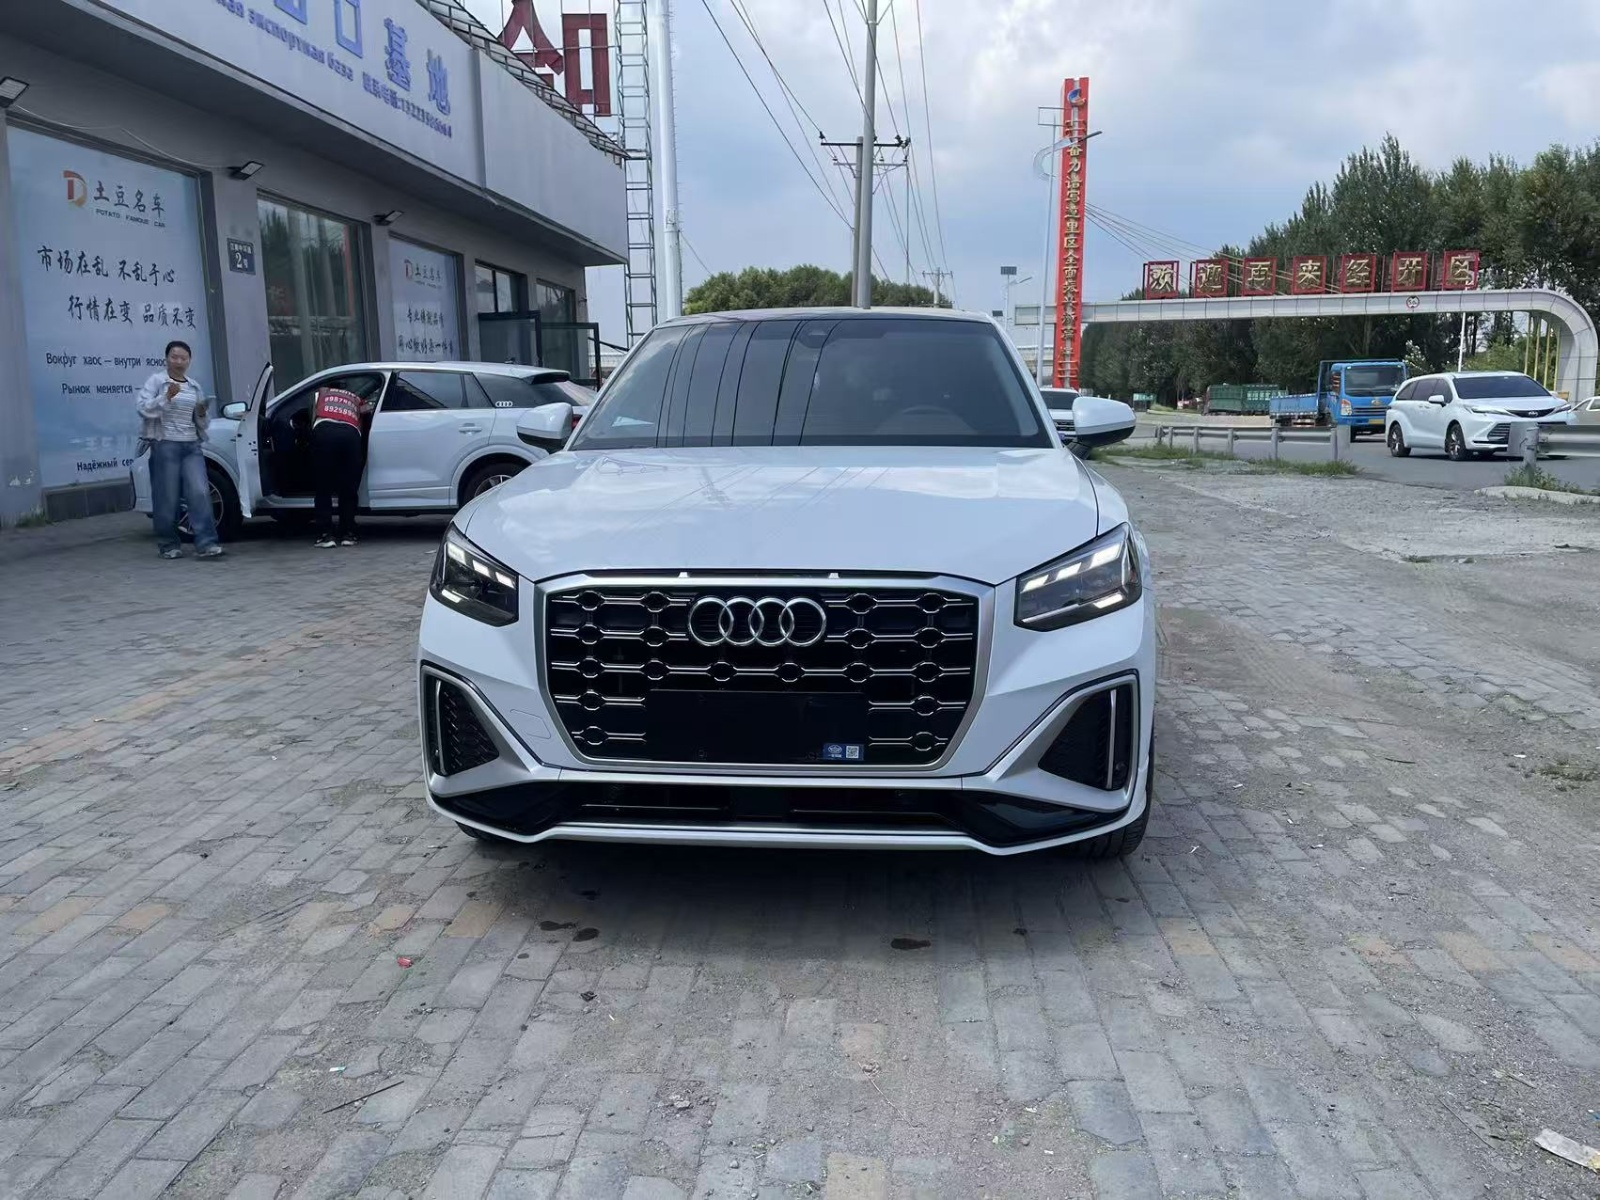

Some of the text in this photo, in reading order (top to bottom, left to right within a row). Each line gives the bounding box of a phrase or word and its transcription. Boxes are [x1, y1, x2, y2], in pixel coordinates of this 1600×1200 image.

[273, 0, 451, 116] 口基地
[93, 180, 165, 218] 土豆名车
[37, 245, 175, 286] 市场在乱 不乱于心
[68, 295, 196, 329] 行情在变 品质不变
[46, 353, 77, 368] Вокруг
[83, 357, 102, 366] хаос
[114, 358, 141, 368] внутри
[62, 383, 91, 395] Рынок
[96, 384, 133, 394] меняется
[77, 457, 118, 471] Надёжный
